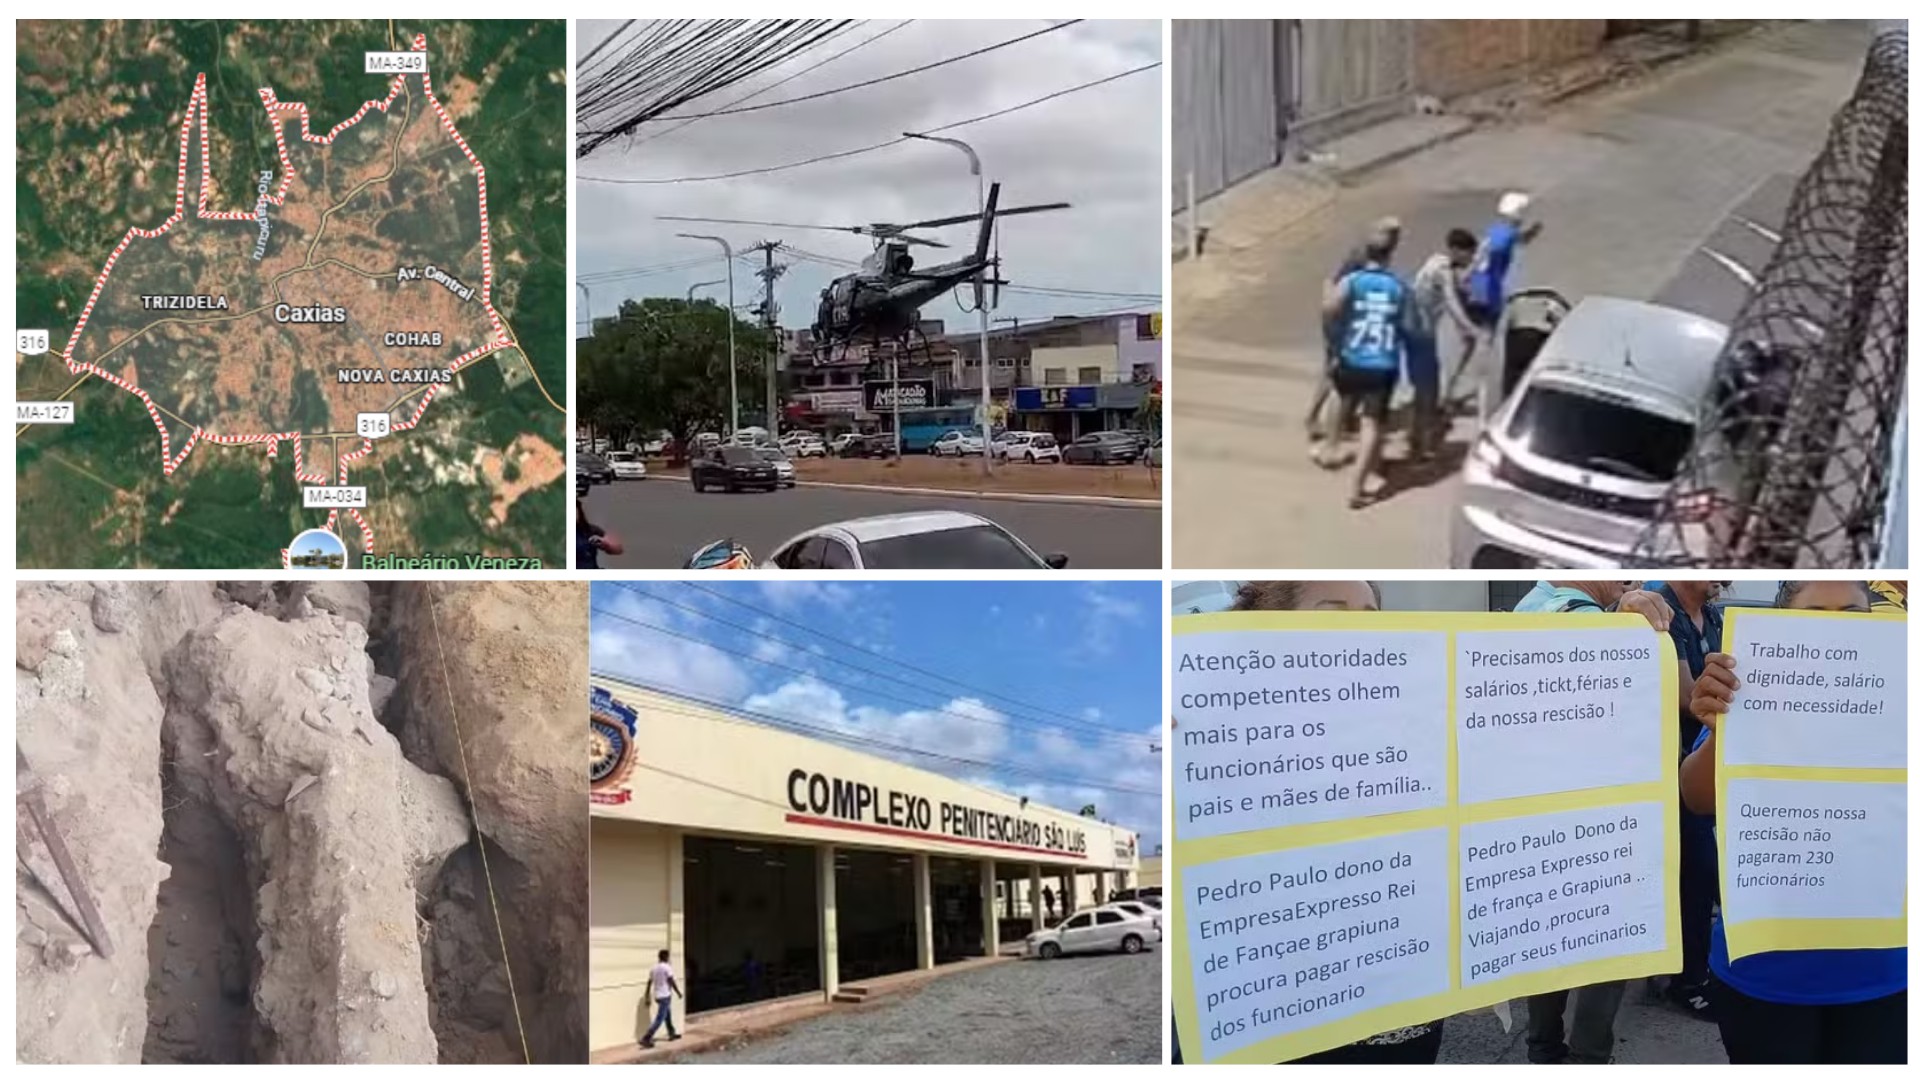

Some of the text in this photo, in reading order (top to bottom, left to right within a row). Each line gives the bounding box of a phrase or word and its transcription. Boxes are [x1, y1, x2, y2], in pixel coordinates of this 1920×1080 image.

[369, 56, 422, 70] MA-349
[258, 171, 273, 194] Rio
[397, 264, 474, 301] Av. Central
[142, 295, 228, 310] TRIZIDELA
[275, 303, 346, 324] Caxias
[20, 335, 46, 349] 316
[384, 332, 442, 347] COHAB
[338, 369, 452, 383] NOVA CAXIAS
[16, 406, 69, 420] MA-127
[360, 419, 386, 433] 316
[309, 489, 362, 503] MA-034
[362, 553, 542, 570] Balneário Veneza
[1178, 647, 1408, 675] Atenção autoridades
[1568, 646, 1596, 663] dos
[1600, 647, 1651, 662] nossos
[1749, 642, 1858, 662] Trabalho com
[1465, 679, 1529, 699] salários
[1622, 676, 1632, 689] e
[1746, 668, 1885, 690] dignidade, salário
[1180, 681, 1400, 711] competentes olhem
[1743, 698, 1884, 715] com necessidade!
[1465, 711, 1486, 730] da
[1491, 711, 1538, 727] nossa
[1542, 702, 1605, 723] rescisão
[1184, 722, 1326, 747] mais para os
[1184, 745, 1408, 783] funcionários que são
[787, 769, 931, 830] COMPLEXO
[940, 802, 1041, 847] PENITENCIÁRIO
[1045, 821, 1064, 850] SÃO
[1188, 795, 1234, 824] pais
[1240, 796, 1254, 812] e
[1261, 787, 1319, 810] mães
[1324, 782, 1350, 802] de
[1740, 803, 1866, 821] Queremos nossa
[1467, 815, 1638, 863] Pedro Paulo Dono da
[1739, 826, 1832, 842] rescisão não
[1465, 841, 1633, 893] Empresa Expresso rei
[1737, 850, 1834, 869] pagaram 230
[1197, 851, 1412, 906] Pedro Paulo dono da
[1736, 871, 1825, 889] funcionários
[1388, 879, 1415, 901] Rei
[1467, 903, 1488, 921] de
[1491, 891, 1544, 915] frança
[1547, 888, 1558, 901] e
[1561, 872, 1632, 898] Grapiuna
[1467, 917, 1541, 948] Viajando
[1203, 952, 1229, 974] de
[1317, 916, 1400, 950] grapiuna
[1470, 922, 1647, 980] pagar seus funcinarios
[1207, 938, 1430, 1011] procura pagar rescisão
[1210, 984, 1365, 1042] dos funcionario
